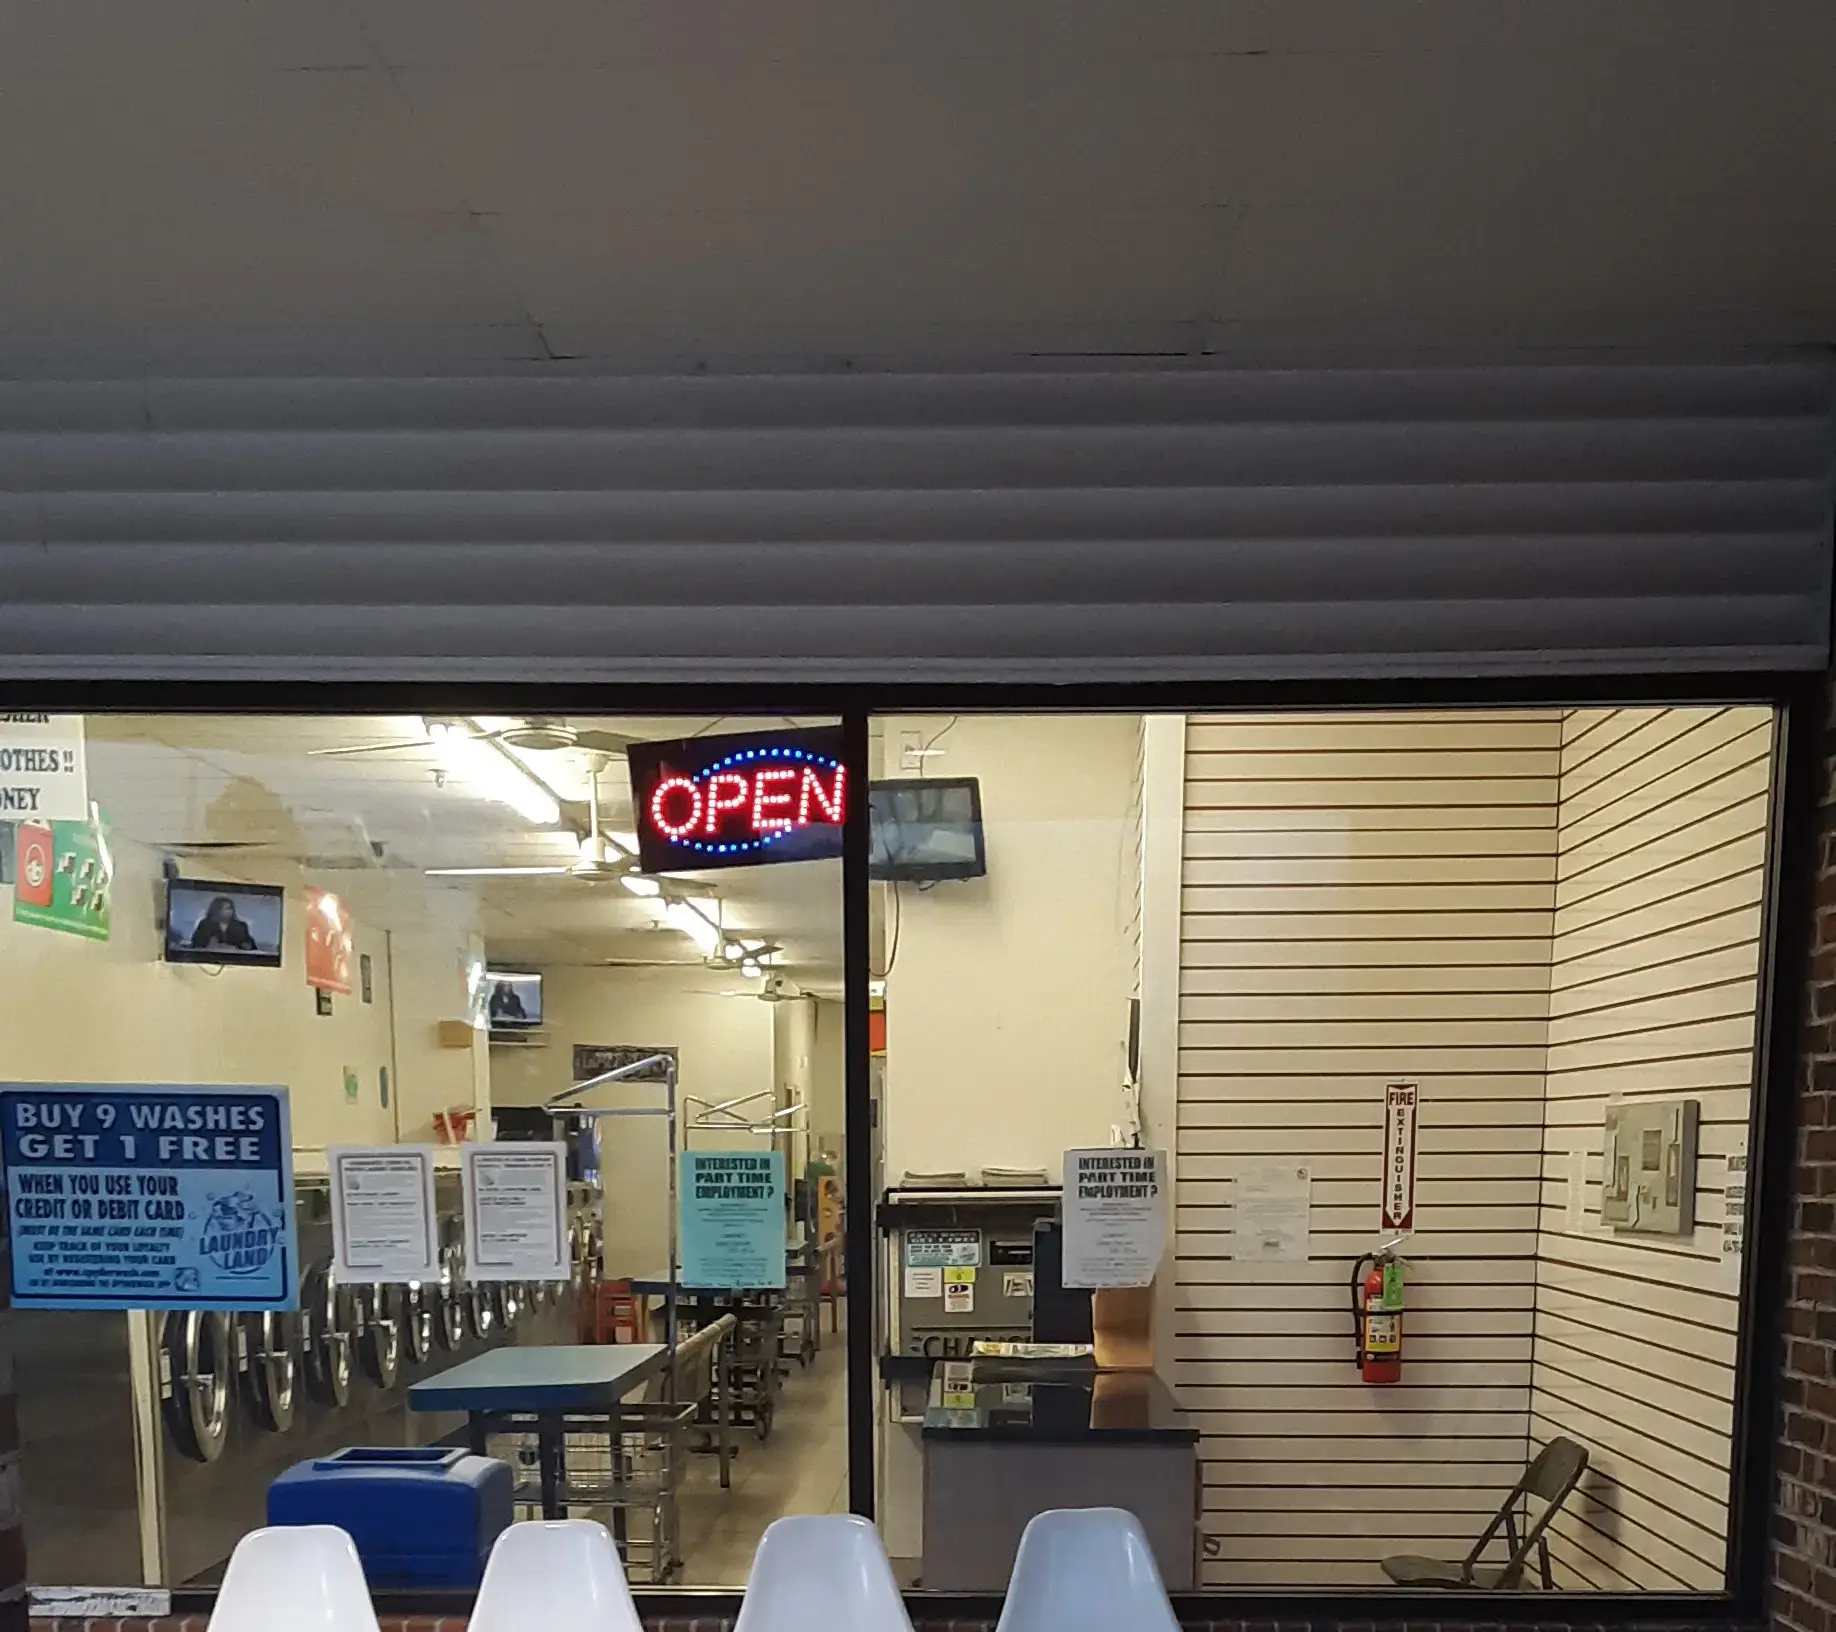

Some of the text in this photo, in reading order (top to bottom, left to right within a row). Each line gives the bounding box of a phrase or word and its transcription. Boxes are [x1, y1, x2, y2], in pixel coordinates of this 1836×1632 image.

[651, 764, 846, 837] OPEN
[1389, 1091, 1414, 1106] FIRE
[16, 1103, 265, 1131] BUY 9 WASHES
[19, 1134, 261, 1161] GET 1 FREE
[695, 1158, 770, 1170] INTERESTED IN
[1078, 1157, 1155, 1170] INTERESTED IN
[1393, 1108, 1405, 1220] EXTINGUISHER
[18, 1173, 179, 1196] WHEN YOU USE YOUR
[695, 1173, 772, 1184] PART TIME
[1079, 1172, 1156, 1183] PART TIME
[696, 1186, 774, 1199] EMPLOYMENT ?
[1079, 1185, 1158, 1198] EMPLOYMENT ?
[15, 1198, 185, 1220] CREDIT OR DEBIT CARD
[199, 1226, 279, 1255] LAUNDRY
[224, 1247, 269, 1270] LAND
